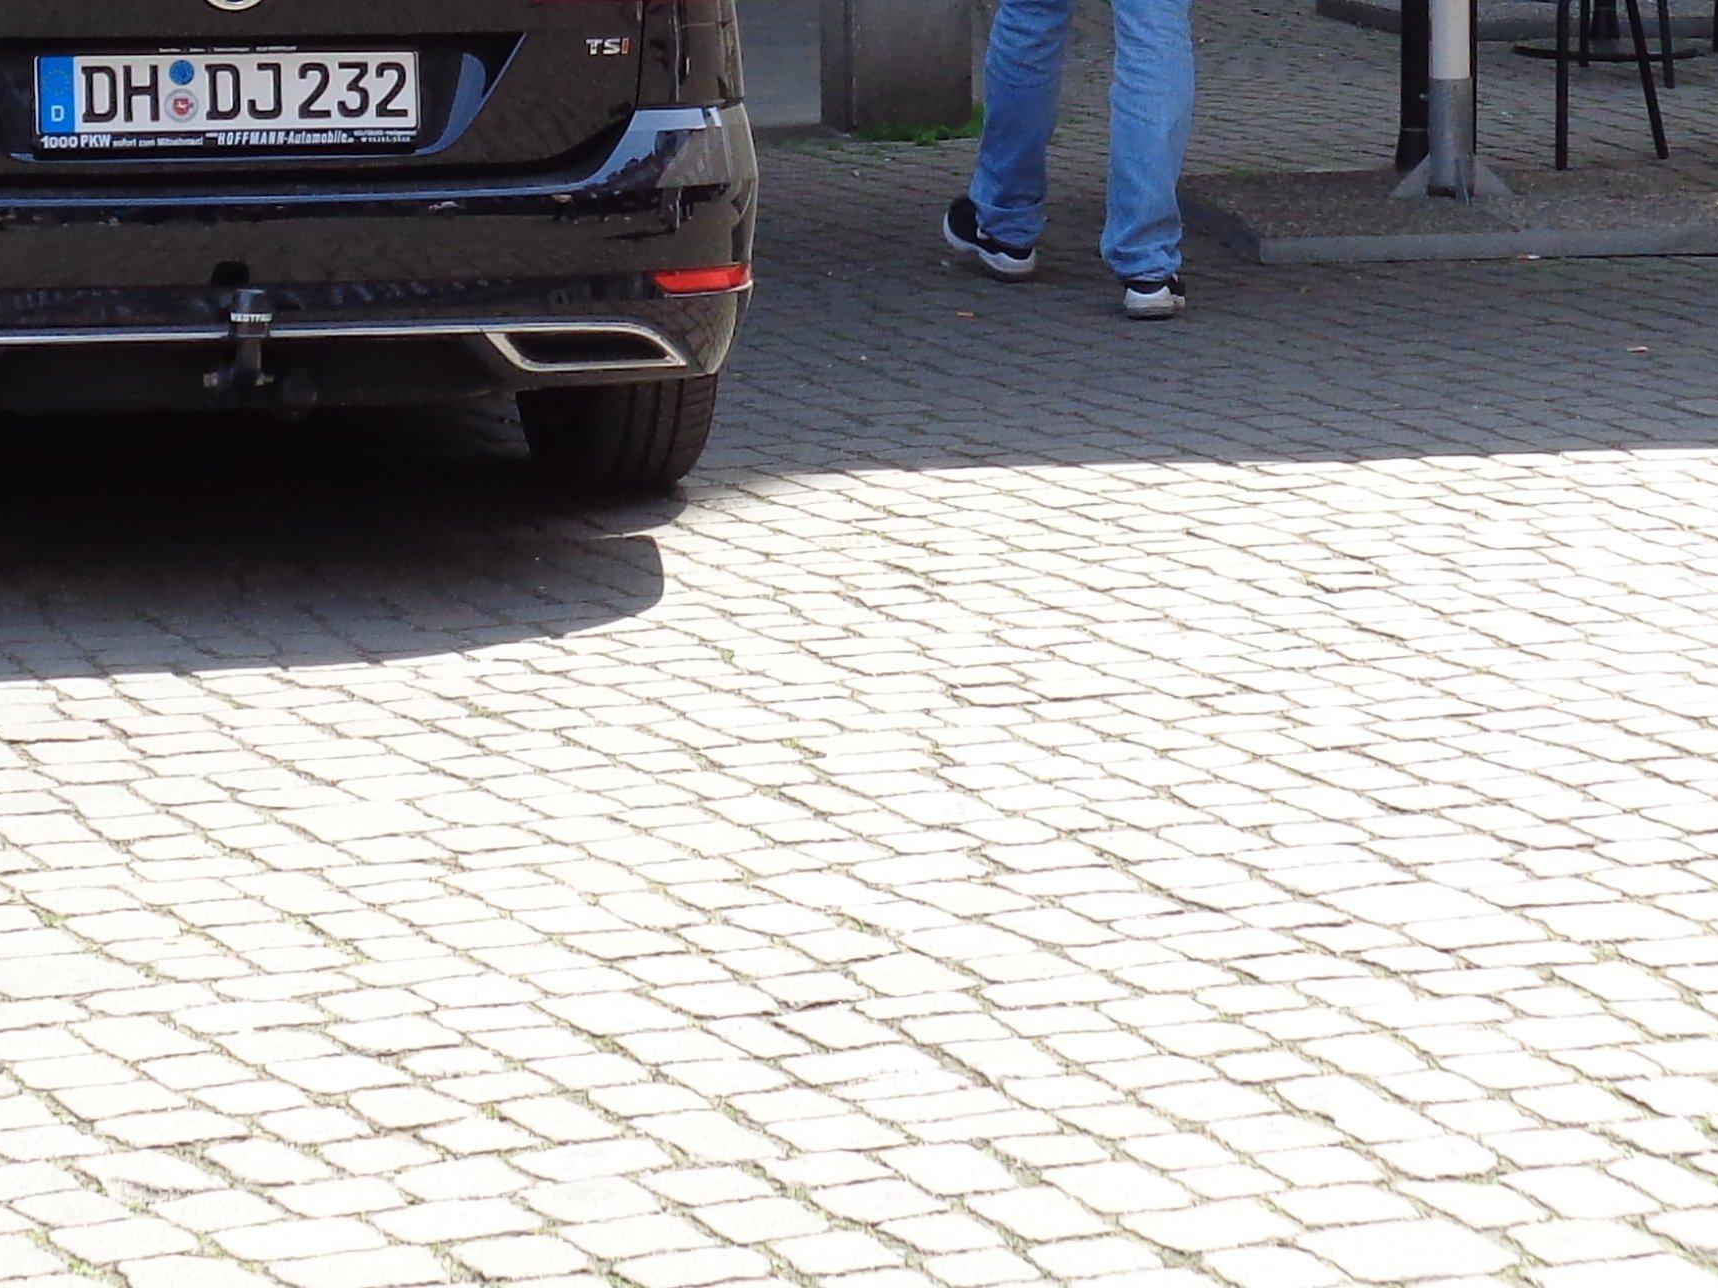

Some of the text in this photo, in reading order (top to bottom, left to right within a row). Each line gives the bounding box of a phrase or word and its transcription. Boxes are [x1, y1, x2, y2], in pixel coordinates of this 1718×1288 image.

[585, 37, 630, 55] TSI
[50, 61, 409, 123] D DH DJ 232
[40, 135, 78, 149] 1000
[80, 133, 111, 148] PKW
